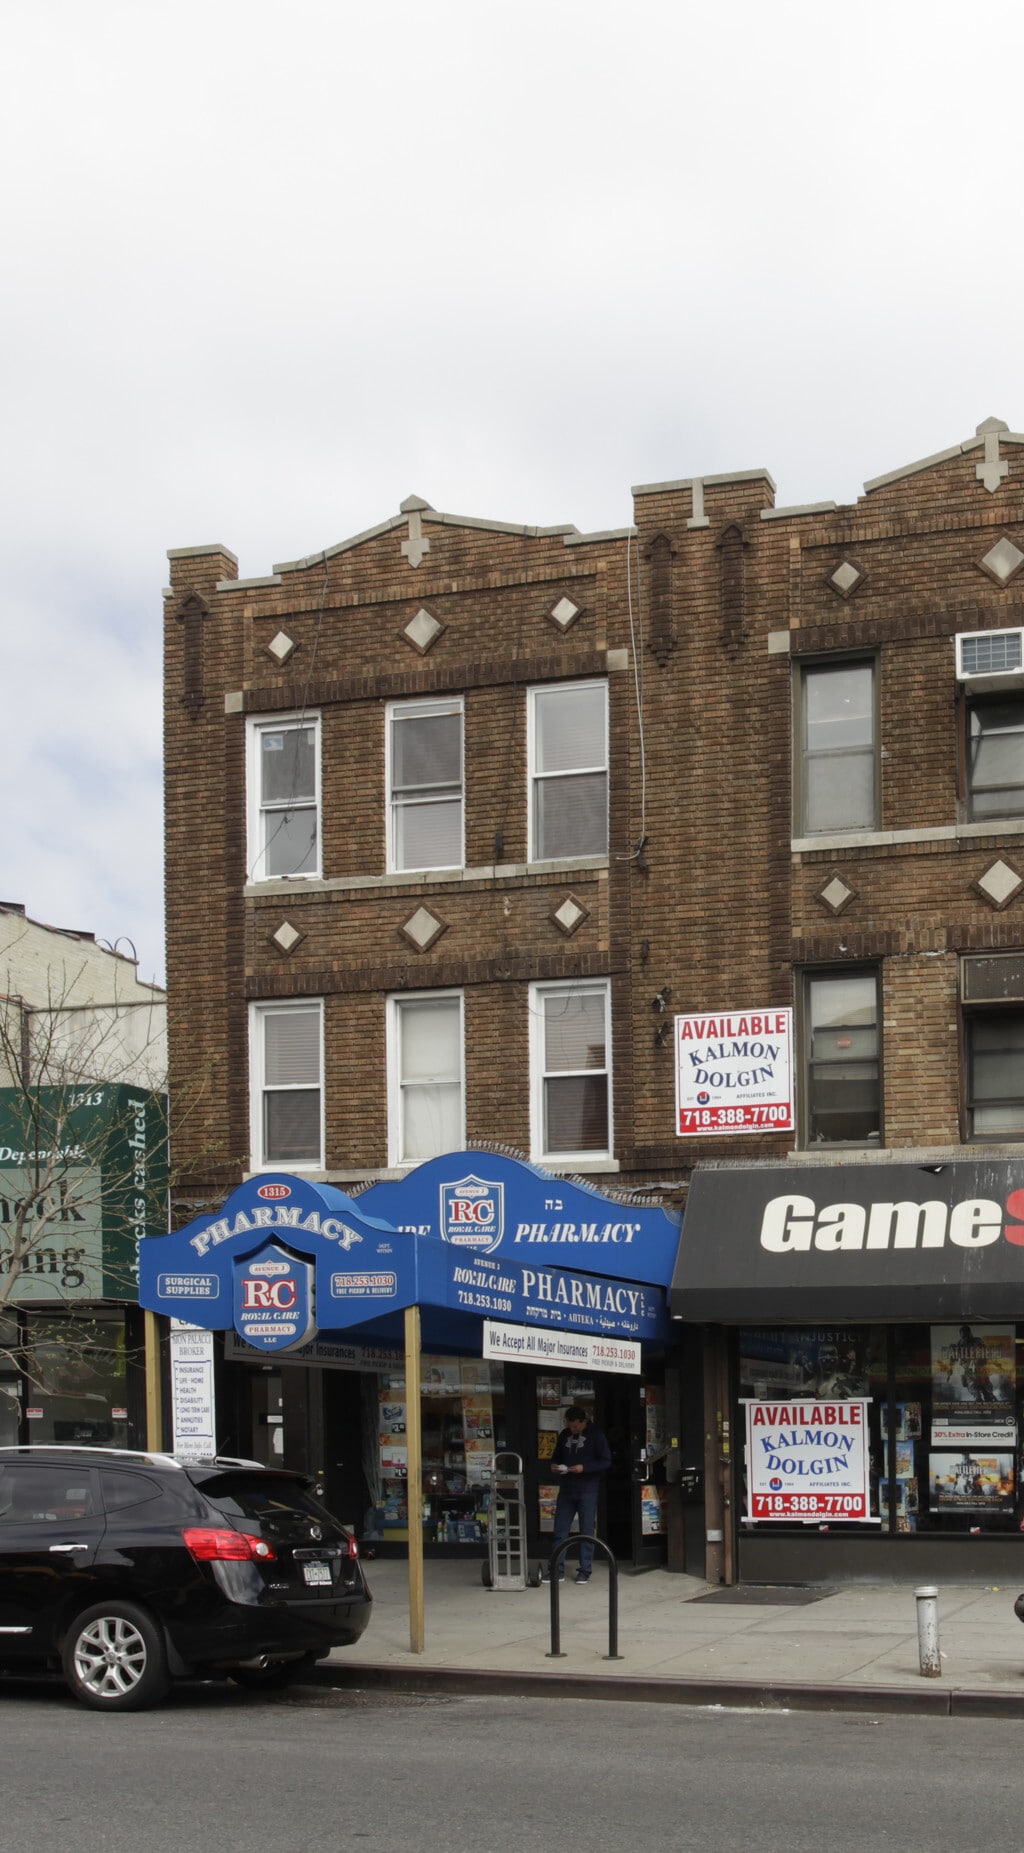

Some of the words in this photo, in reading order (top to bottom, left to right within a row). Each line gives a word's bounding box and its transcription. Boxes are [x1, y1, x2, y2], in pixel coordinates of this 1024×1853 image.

[681, 1015, 786, 1040] AVAILABLE
[688, 1041, 780, 1067] KALMON
[693, 1064, 774, 1088] DOLGIN
[684, 1106, 787, 1125] 718-388-7700
[697, 1122, 774, 1132] www.kalmondolgin.com
[264, 1187, 286, 1197] 1315
[448, 1199, 495, 1225] RC
[190, 1206, 363, 1257] PHARMACY
[448, 1225, 473, 1233] ROYAL
[514, 1223, 641, 1243] PHARMACY
[473, 1258, 496, 1269] AVENUE
[165, 1277, 212, 1286] SURGICAL
[335, 1276, 394, 1286] 718.253.1030
[166, 1286, 210, 1295] SUPPLIES
[242, 1279, 297, 1310] RC
[522, 1269, 640, 1316] PHARMACY
[458, 1291, 512, 1312] 718.253.1030
[241, 1312, 272, 1320] ROYAL
[273, 1311, 300, 1320] CARE
[179, 1347, 204, 1355] BROKER
[234, 1334, 245, 1349] We
[316, 1343, 355, 1359] Insurances
[490, 1331, 500, 1346] We
[503, 1333, 524, 1351] Accept
[527, 1336, 535, 1349] All
[538, 1338, 556, 1356] Major
[557, 1341, 588, 1357] Insurances
[592, 1345, 636, 1360] 718.253.1030
[942, 1346, 1002, 1359] BATTLEFIELD
[618, 1361, 635, 1369] DELIVERY
[969, 1360, 976, 1373] 4
[753, 1406, 861, 1426] AVAILABLE
[760, 1430, 855, 1453] KALMON
[765, 1454, 849, 1475] DOLGIN
[756, 1496, 862, 1511] 718-388-7700
[769, 1511, 849, 1519] www.kalmondolgin.com
